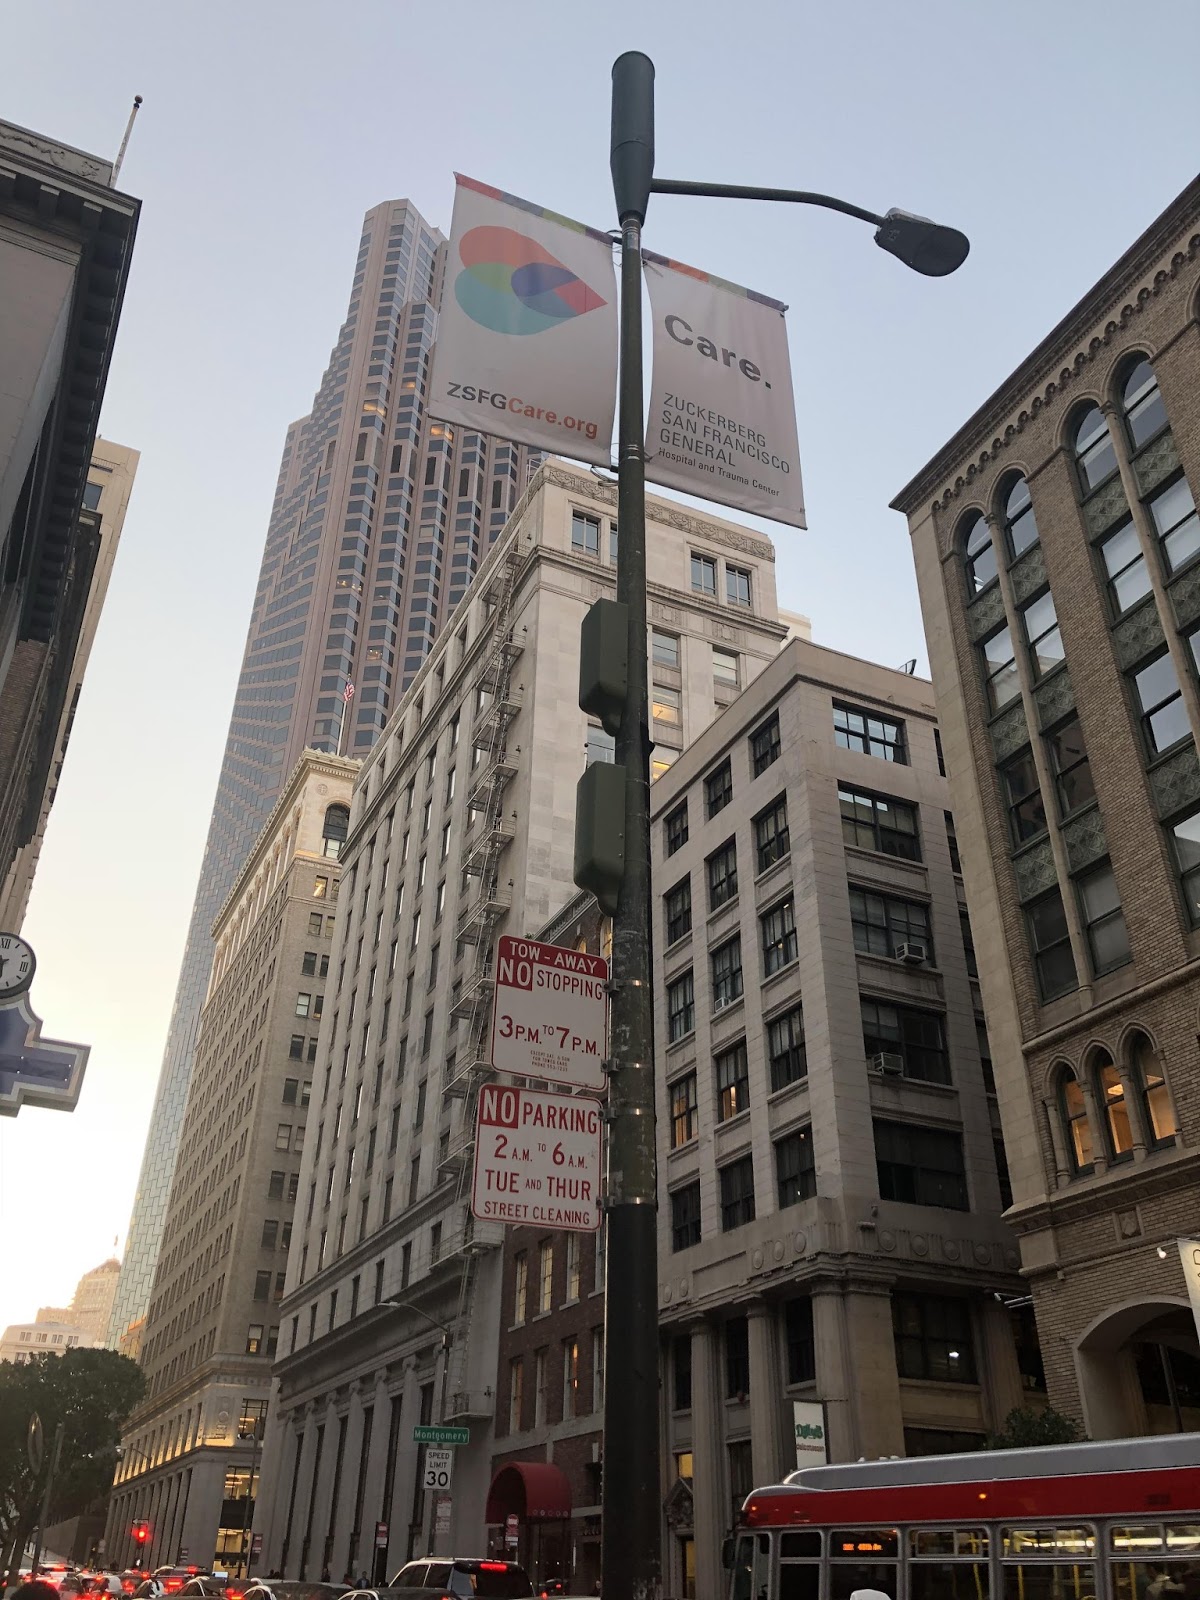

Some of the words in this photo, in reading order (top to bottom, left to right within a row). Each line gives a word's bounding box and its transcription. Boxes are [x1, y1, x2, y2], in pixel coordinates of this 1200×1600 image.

[664, 314, 772, 389] Care.
[447, 382, 598, 439] ZSFGCare.org
[663, 393, 767, 448] ZUCKERBERG
[660, 430, 736, 467] GENERAL
[661, 411, 697, 435] SAN
[702, 425, 790, 474] FRANCISCO
[658, 447, 696, 470] Hospital
[698, 458, 715, 473] and
[717, 465, 749, 485] Trauma
[752, 477, 780, 496] Center
[510, 941, 541, 961] TOW
[554, 952, 597, 974] AWAY
[499, 957, 531, 987] NO
[537, 969, 602, 1000] STOPPING
[483, 1089, 515, 1124] NO
[523, 1102, 597, 1134] PARKING
[537, 1143, 547, 1152] TO
[485, 1169, 520, 1193] TUE
[525, 1178, 542, 1190] AND
[547, 1176, 591, 1201] THUR
[484, 1201, 529, 1218] STREET
[533, 1206, 590, 1225] CLEANING
[414, 1430, 467, 1442] Montgomery
[426, 1471, 448, 1487] 30
